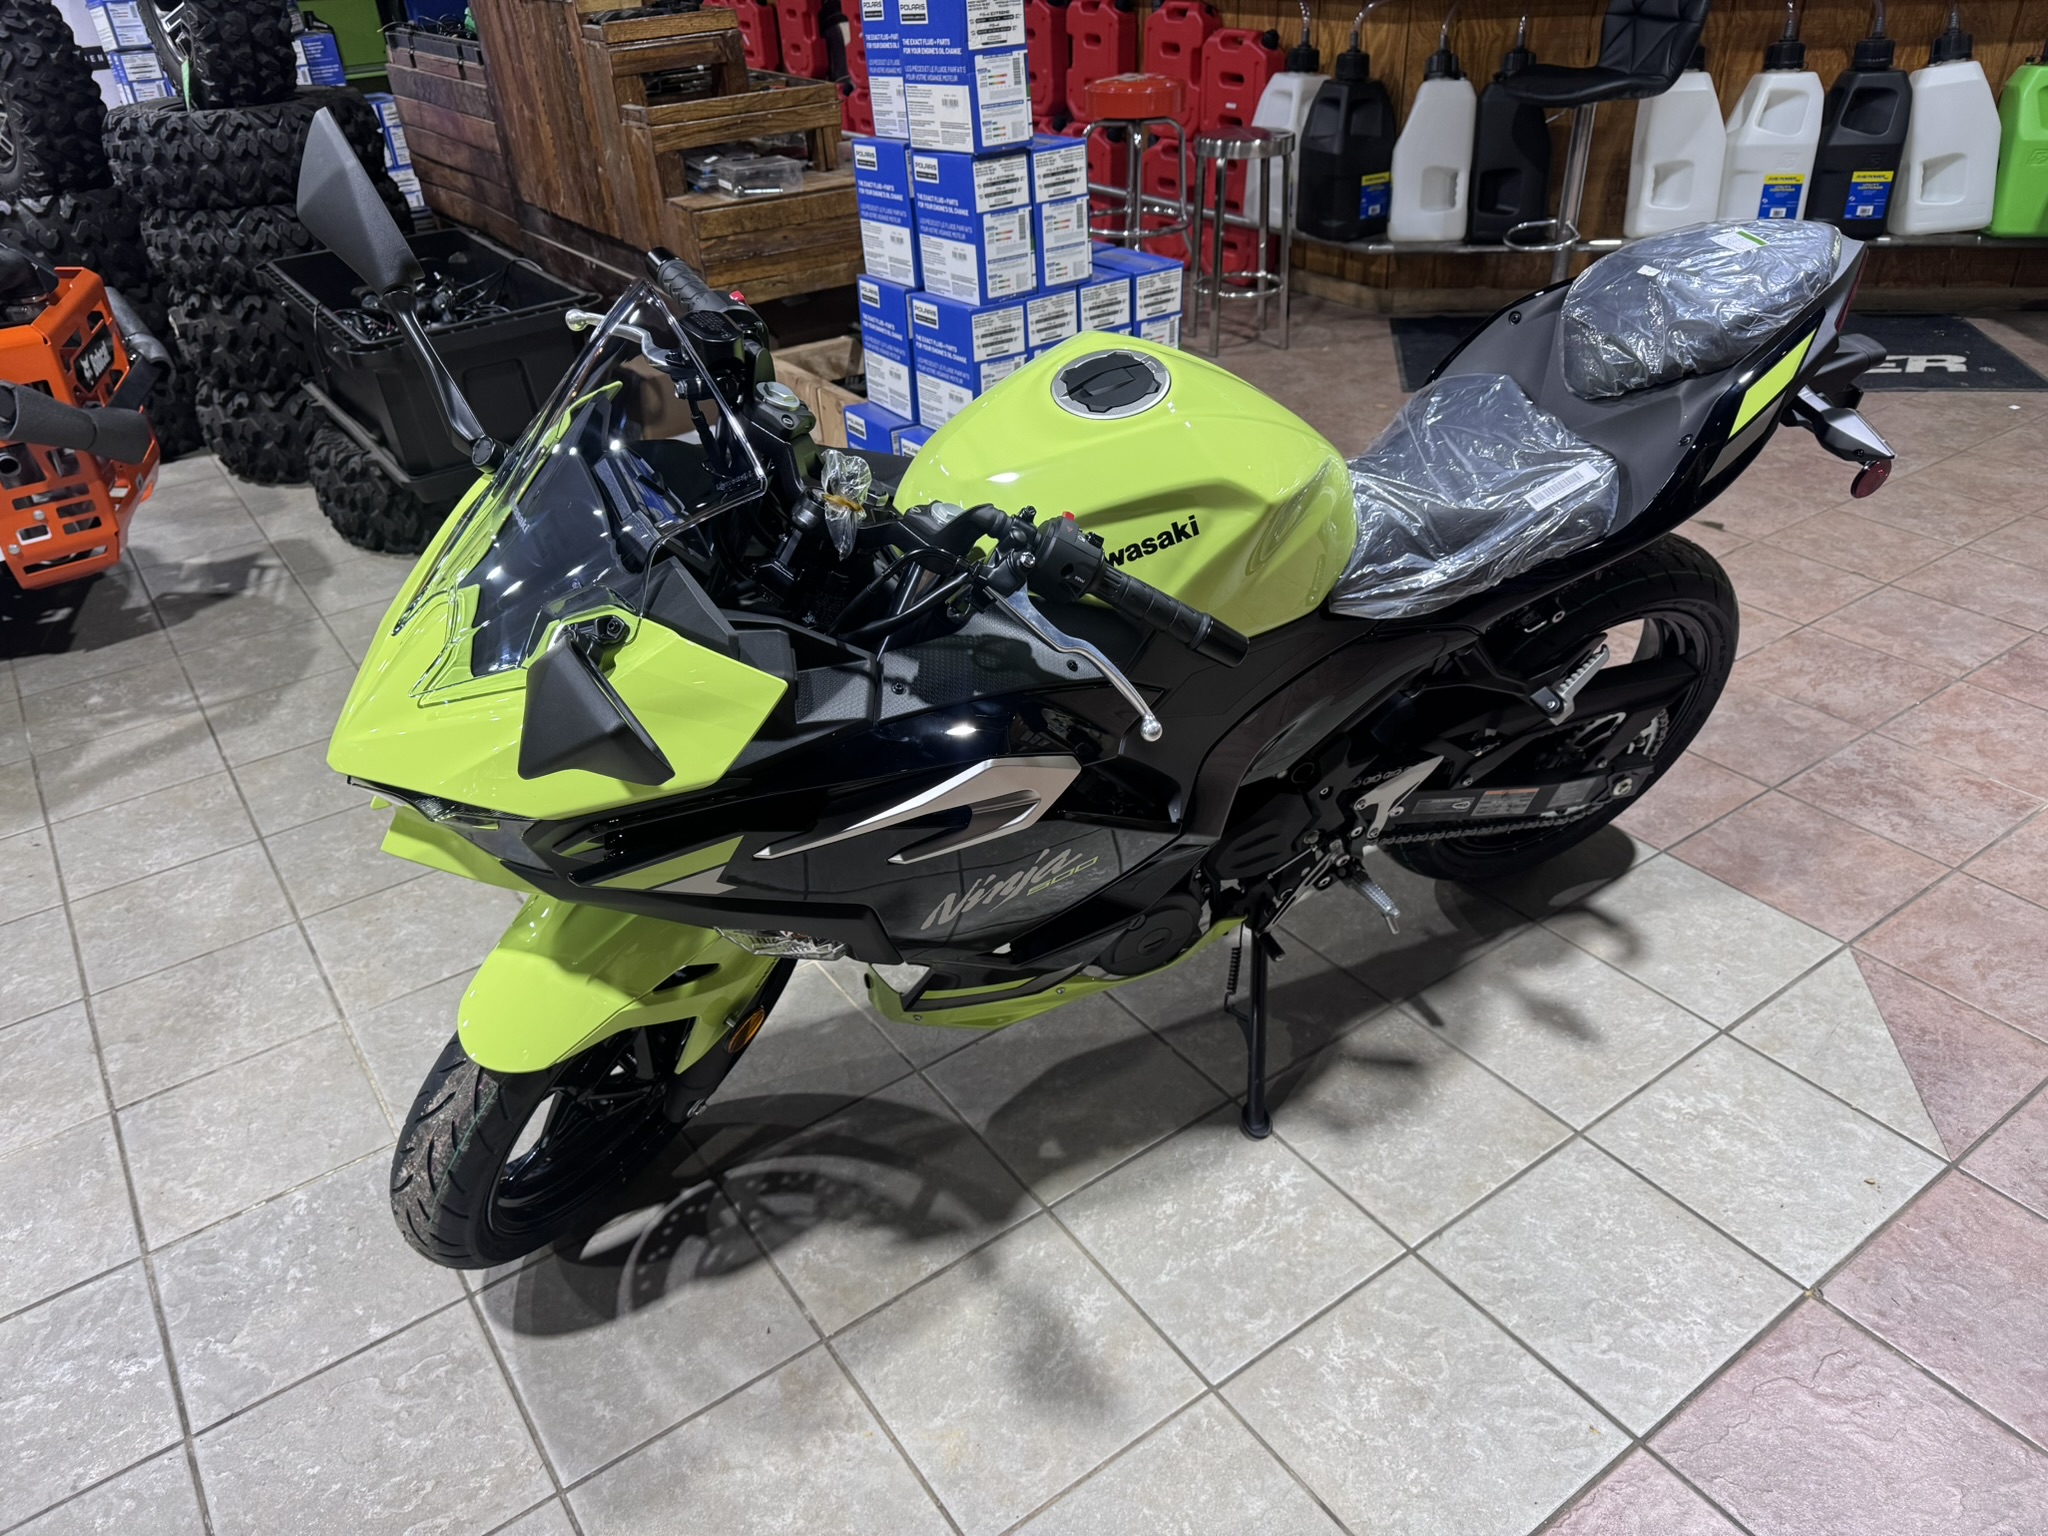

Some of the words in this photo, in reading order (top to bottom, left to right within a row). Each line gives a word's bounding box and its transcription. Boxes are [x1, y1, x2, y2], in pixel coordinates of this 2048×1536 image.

[915, 162, 937, 171] POLARIS
[914, 305, 936, 316] POLARIS
[920, 849, 1083, 931] Ninja
[1027, 856, 1098, 896] 500
